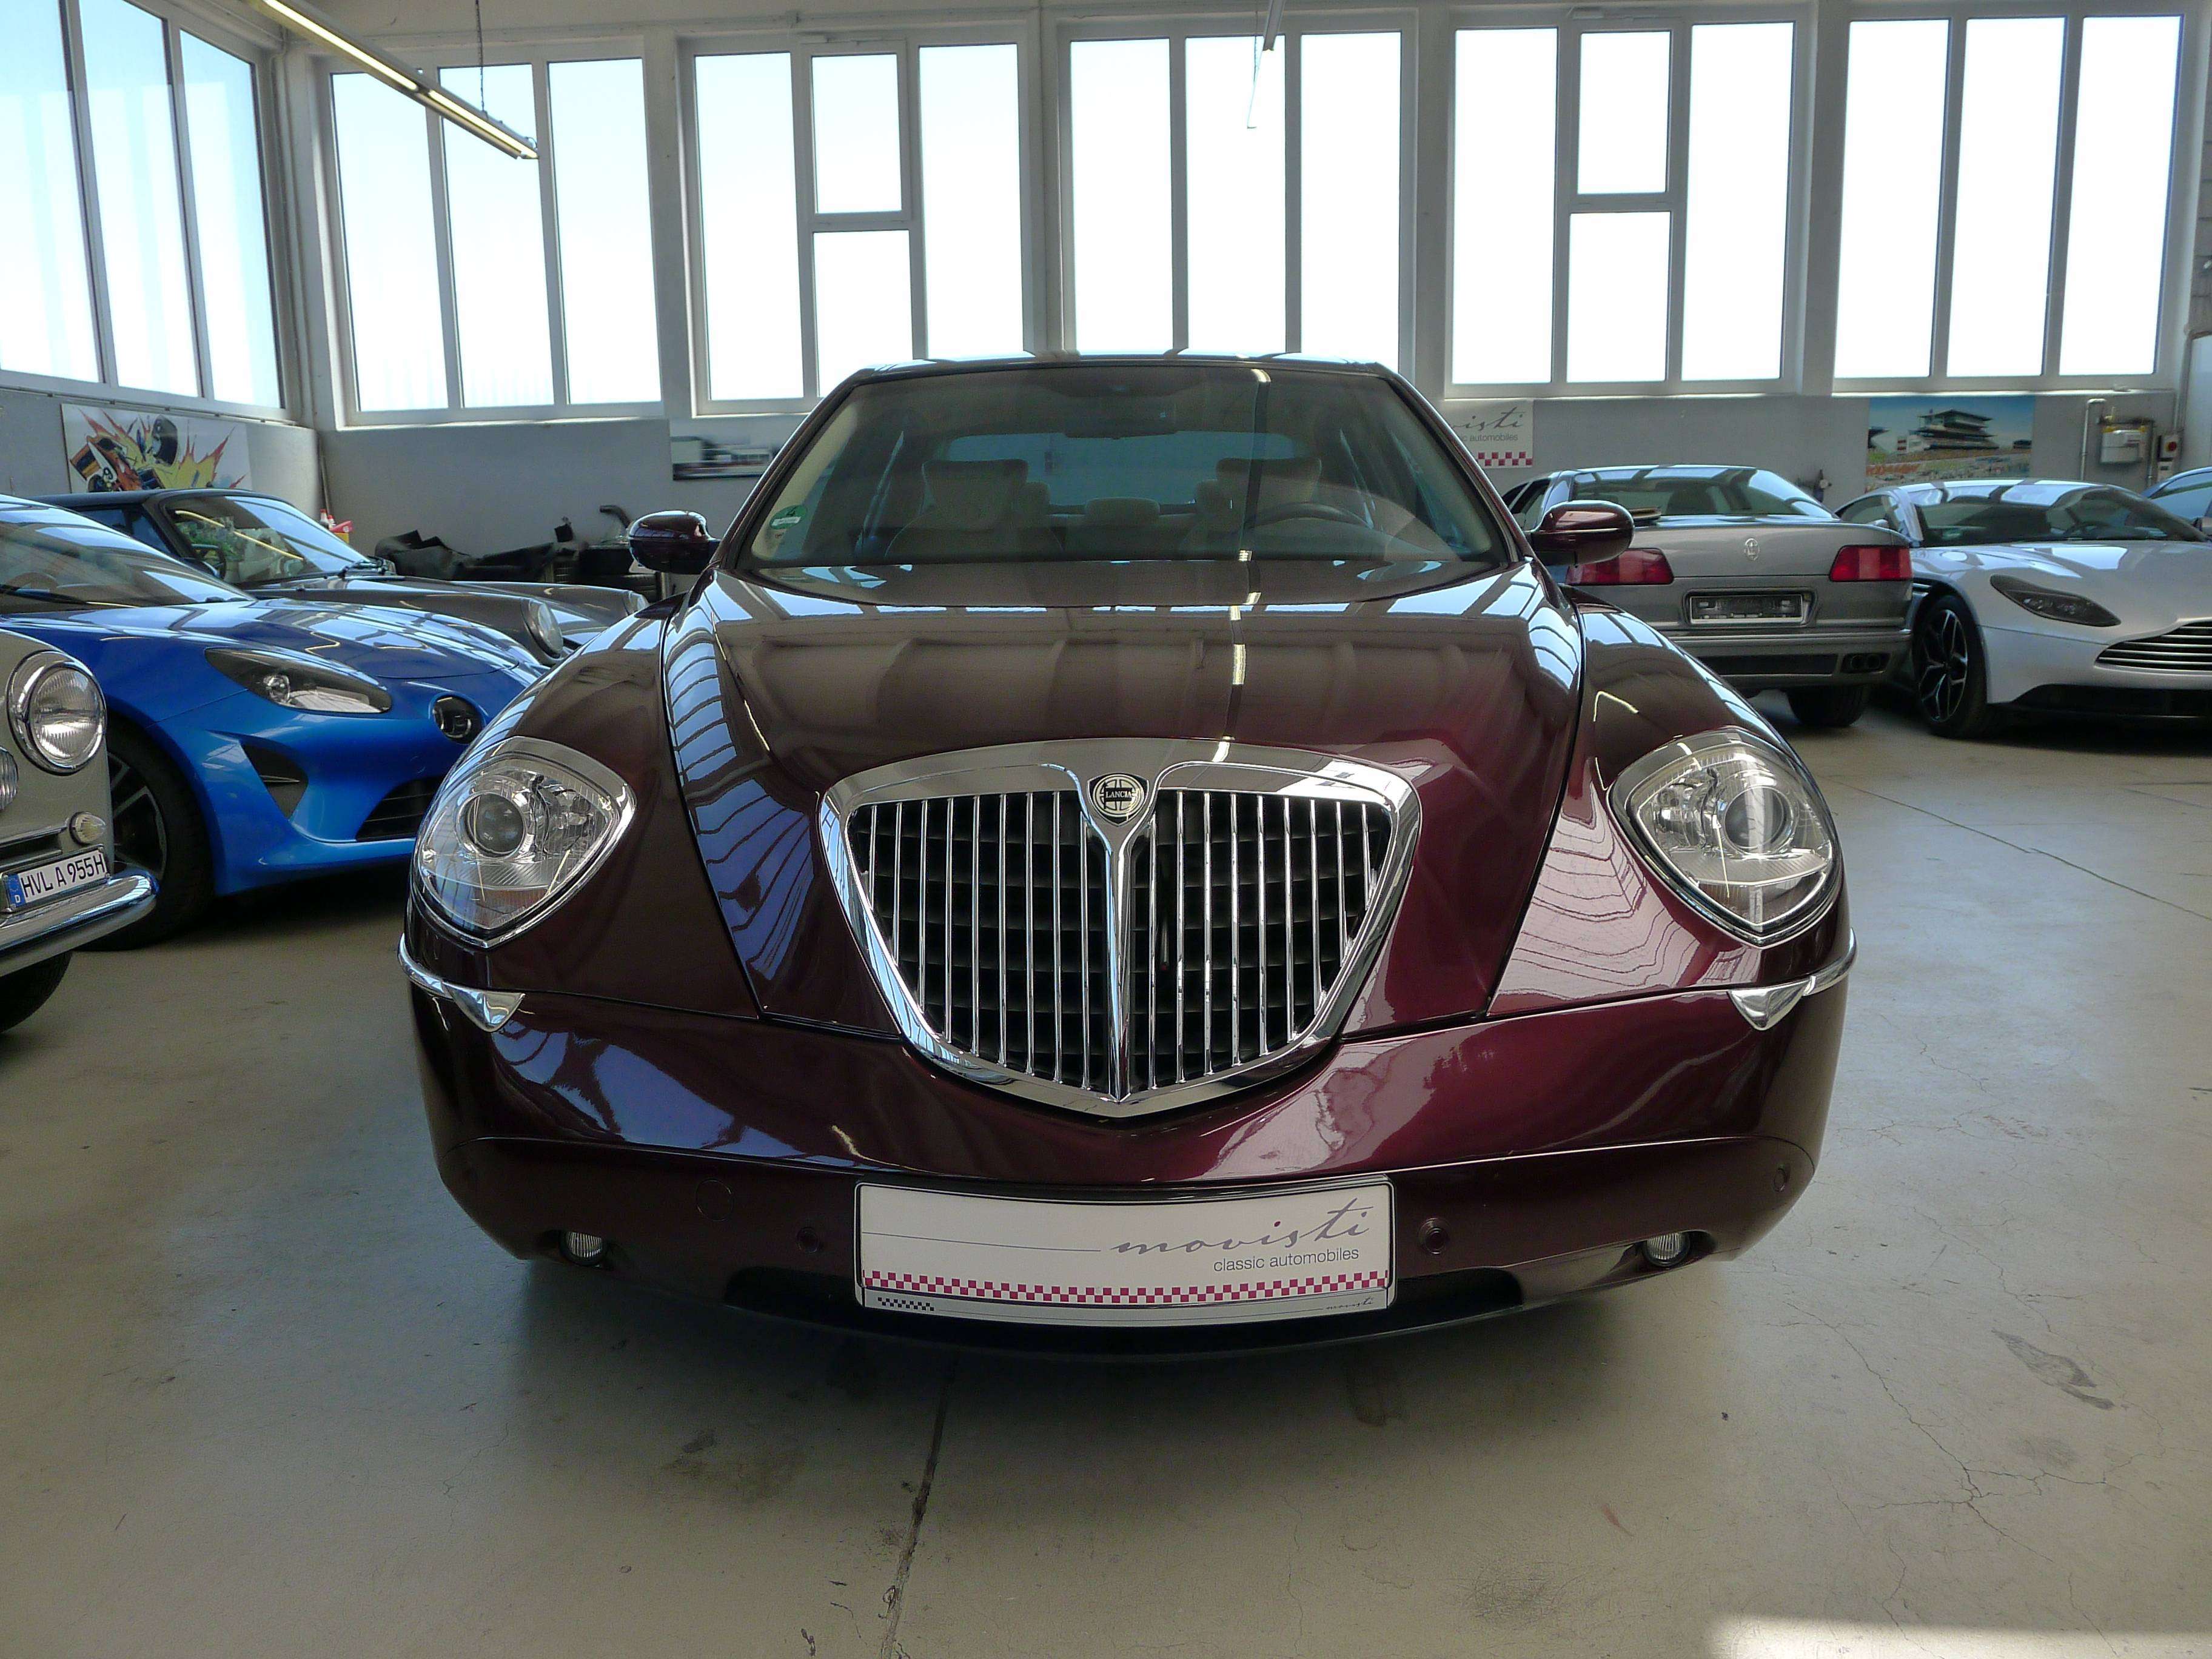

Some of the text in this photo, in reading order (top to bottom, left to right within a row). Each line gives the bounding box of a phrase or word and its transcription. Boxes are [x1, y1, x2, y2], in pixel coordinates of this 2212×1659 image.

[1469, 434, 1518, 442] automobiles
[21, 854, 106, 898] HVL A 955H
[14, 894, 21, 903] D
[1110, 1198, 1374, 1255] movisti
[1213, 1248, 1359, 1273] classic automobiles
